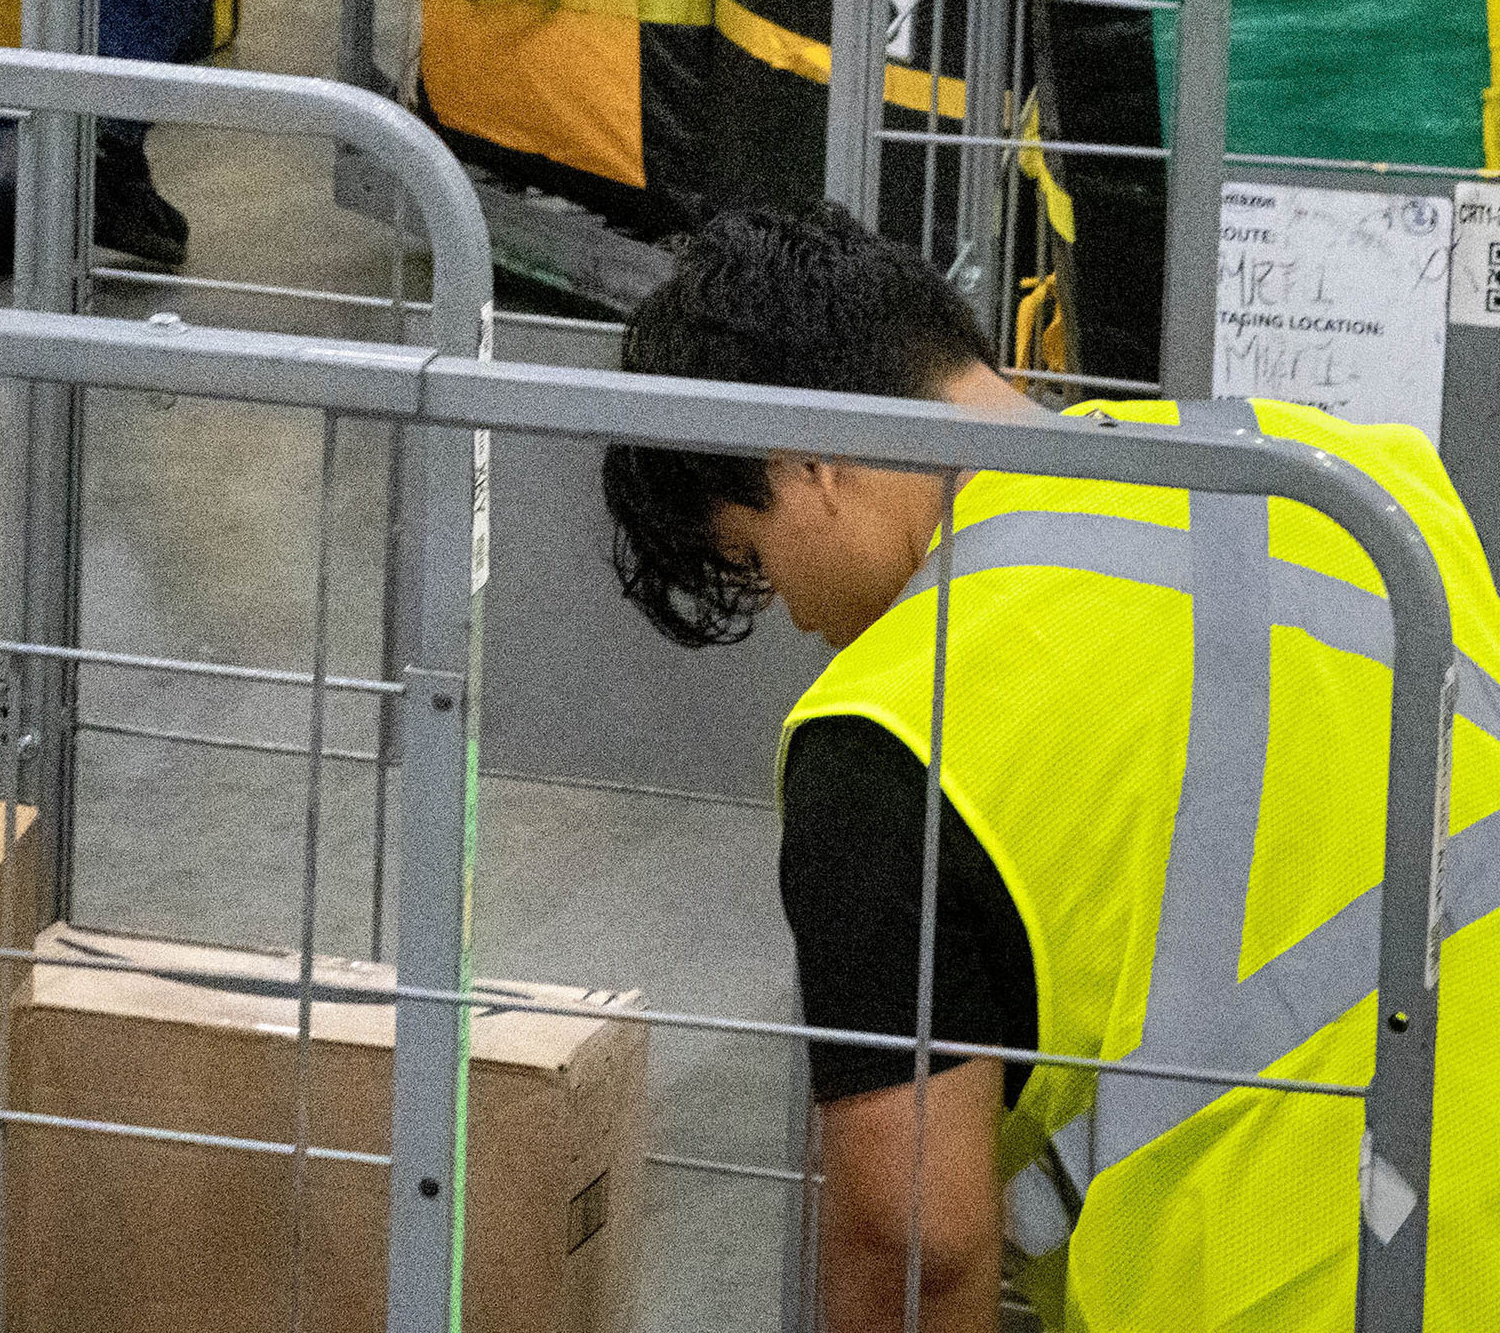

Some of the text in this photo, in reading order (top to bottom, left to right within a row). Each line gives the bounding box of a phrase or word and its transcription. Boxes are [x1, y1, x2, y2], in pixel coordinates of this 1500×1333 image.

[1221, 228, 1277, 246] OUTE:
[1220, 310, 1383, 338] TAGING LOCATION:
